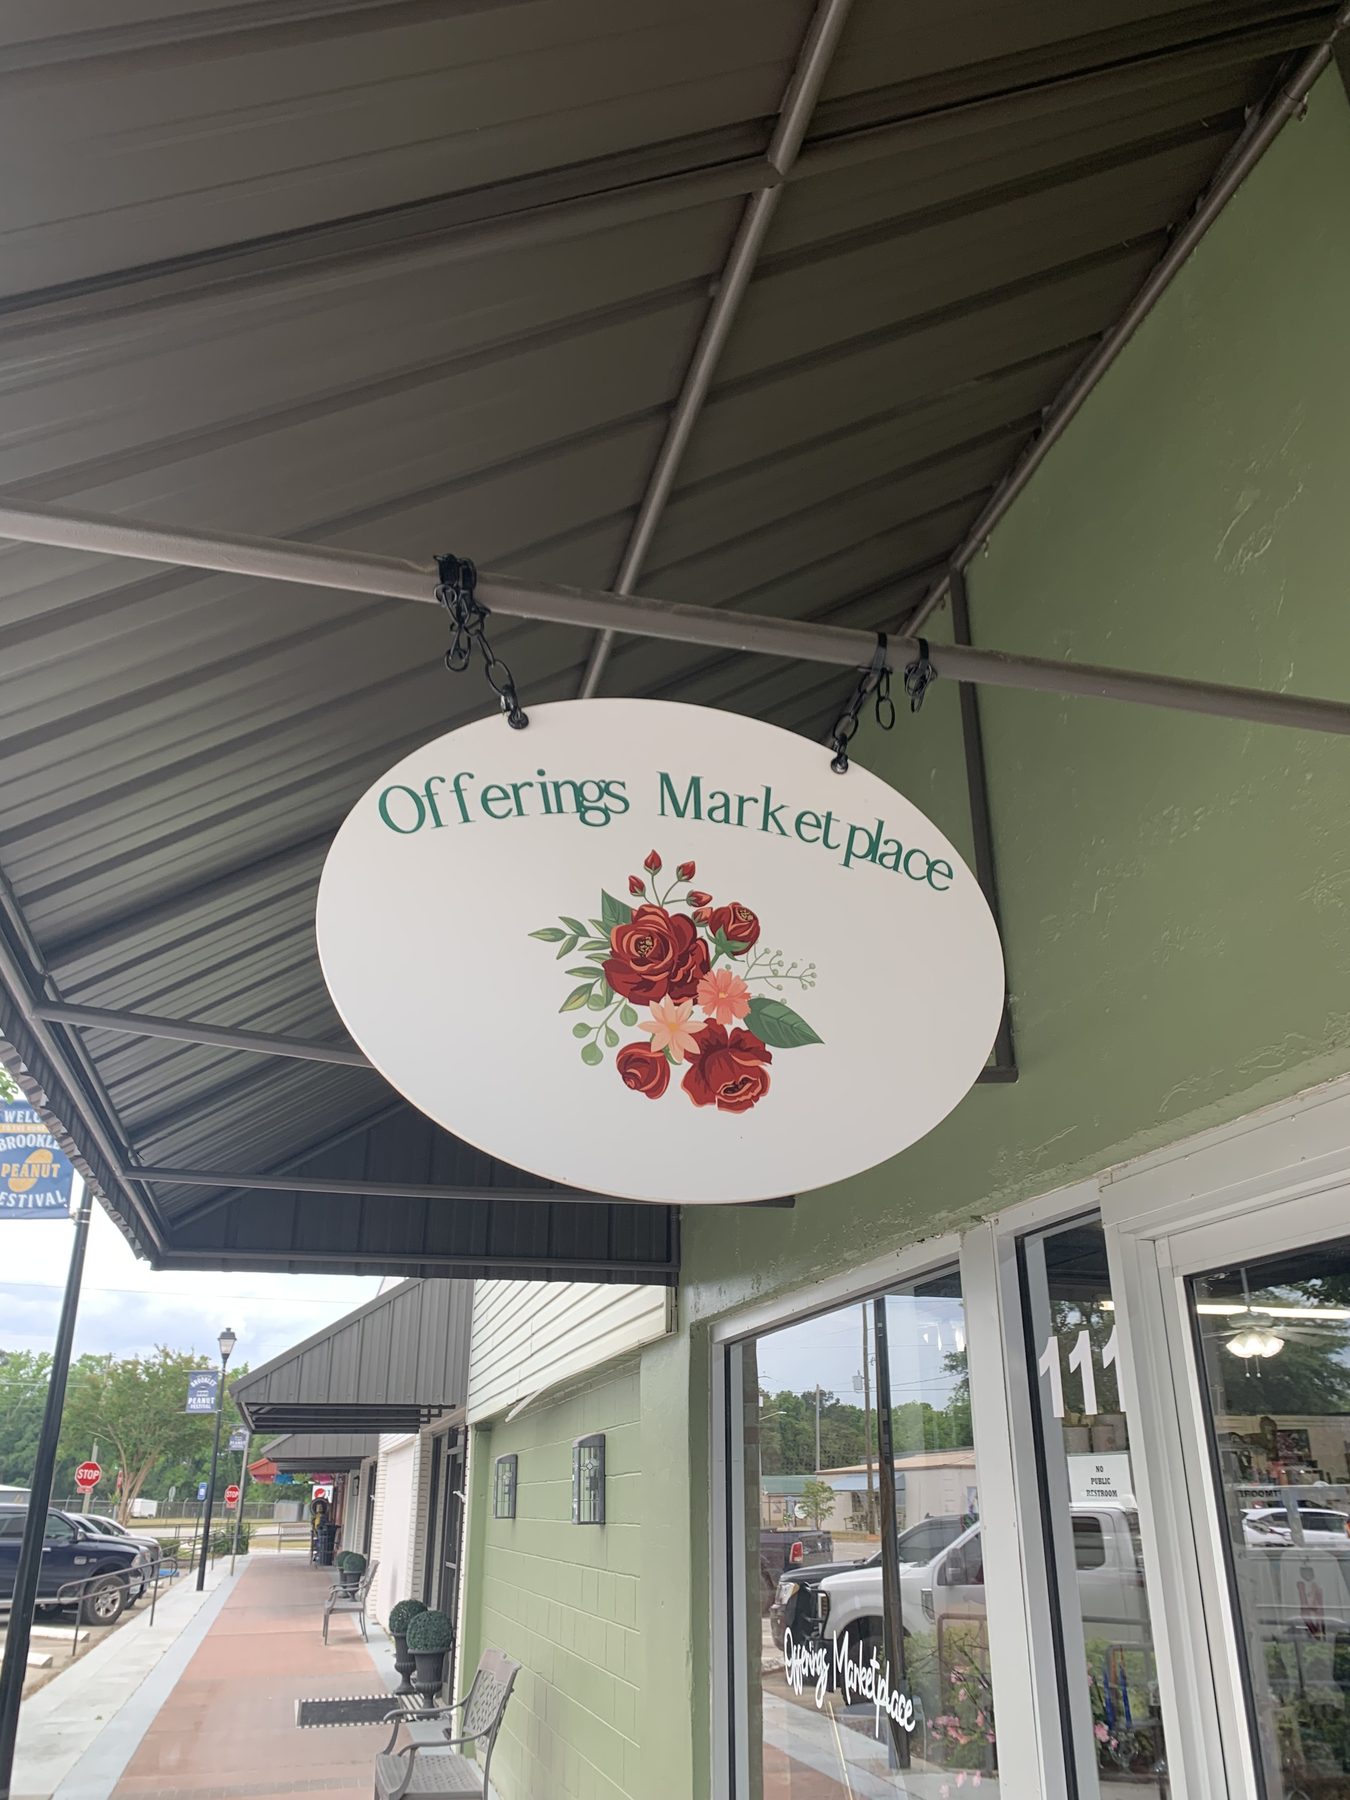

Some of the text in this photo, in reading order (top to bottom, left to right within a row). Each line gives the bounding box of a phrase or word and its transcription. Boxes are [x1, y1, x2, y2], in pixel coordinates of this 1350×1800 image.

[378, 768, 954, 891] Offerings Marketplace
[1, 1163, 61, 1178] PEANUT
[1095, 1465, 1104, 1473] NO
[77, 1469, 99, 1480] STOP
[1090, 1477, 1111, 1485] PUBLIC
[226, 1490, 239, 1498] STOP
[1085, 1489, 1118, 1497] RESTROOM
[833, 1630, 916, 1739] Marketplace
